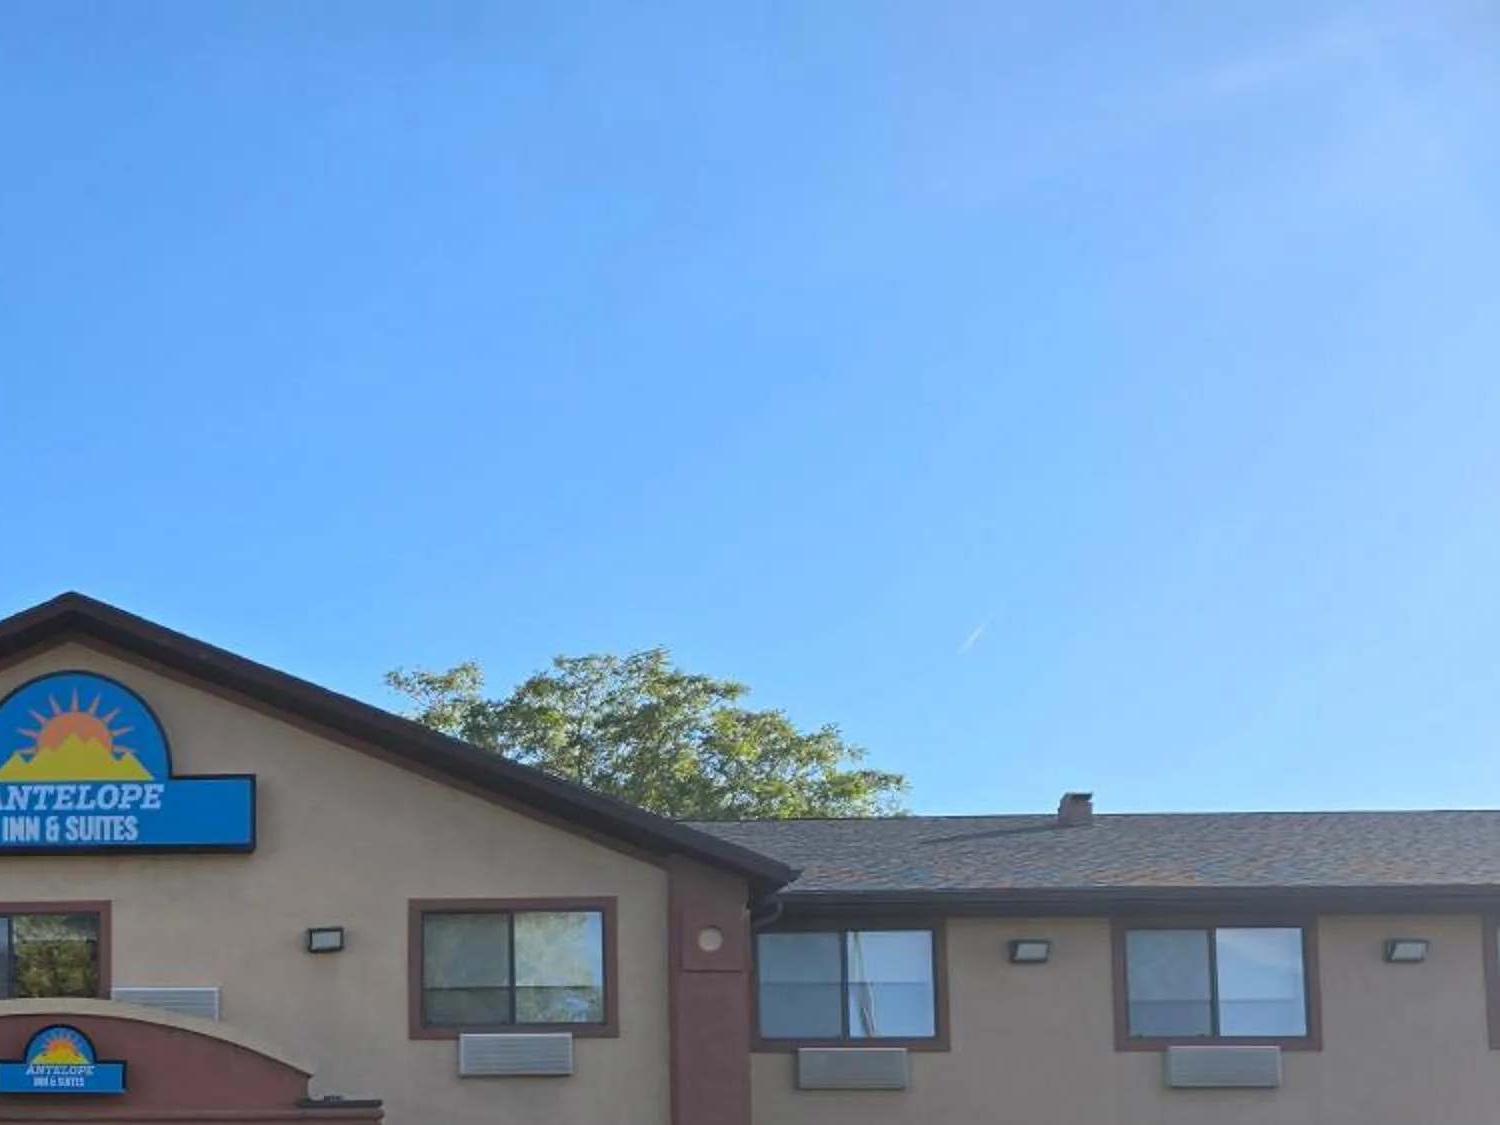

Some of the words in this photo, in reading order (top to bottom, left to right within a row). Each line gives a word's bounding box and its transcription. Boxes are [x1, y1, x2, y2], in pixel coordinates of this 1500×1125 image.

[2, 815, 41, 842] INN
[45, 815, 60, 842] &
[65, 815, 139, 841] SUITES
[26, 1065, 95, 1076] ANTELOPE
